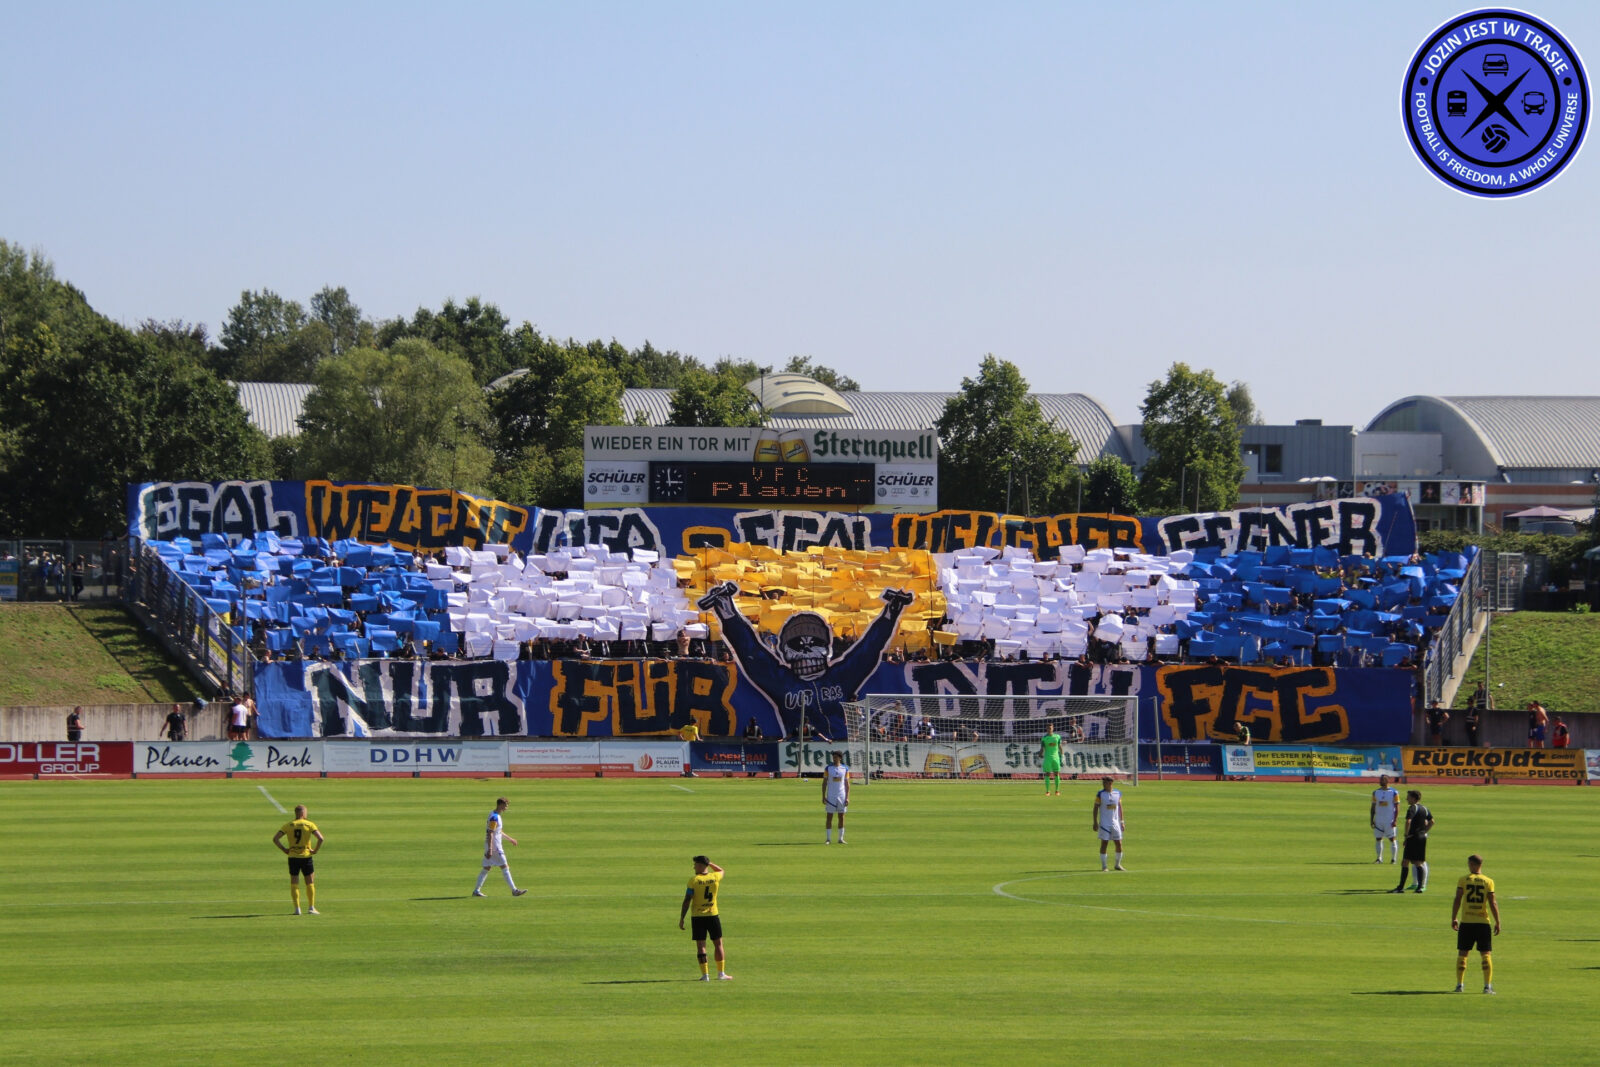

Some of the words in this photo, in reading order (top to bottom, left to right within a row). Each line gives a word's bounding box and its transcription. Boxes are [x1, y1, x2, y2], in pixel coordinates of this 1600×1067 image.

[591, 436, 652, 450] WIEDER
[657, 437, 683, 450] EIN
[688, 437, 718, 450] TOR
[724, 438, 750, 451] MIT
[813, 430, 932, 462] Sternquell
[587, 470, 646, 483] SCHÜLER
[752, 467, 763, 481] V
[877, 472, 934, 486] SCHÜLER
[712, 482, 846, 498] Plauen
[138, 480, 298, 545] EGAL
[304, 661, 528, 738] NUR
[549, 660, 738, 737] FÜR
[1156, 665, 1349, 742] FCC
[146, 745, 219, 769] Plauen
[267, 745, 312, 769] Park
[370, 748, 463, 763] DDHW
[1271, 752, 1299, 760] ELSTER
[1412, 748, 1546, 768] Rückoldt
[40, 763, 100, 773] GROUP
[1437, 768, 1493, 777] PEUGEOT
[1528, 769, 1585, 779] PEUGEOT
[294, 829, 302, 844] 9
[704, 886, 713, 902] 4
[1466, 884, 1485, 904] 25
